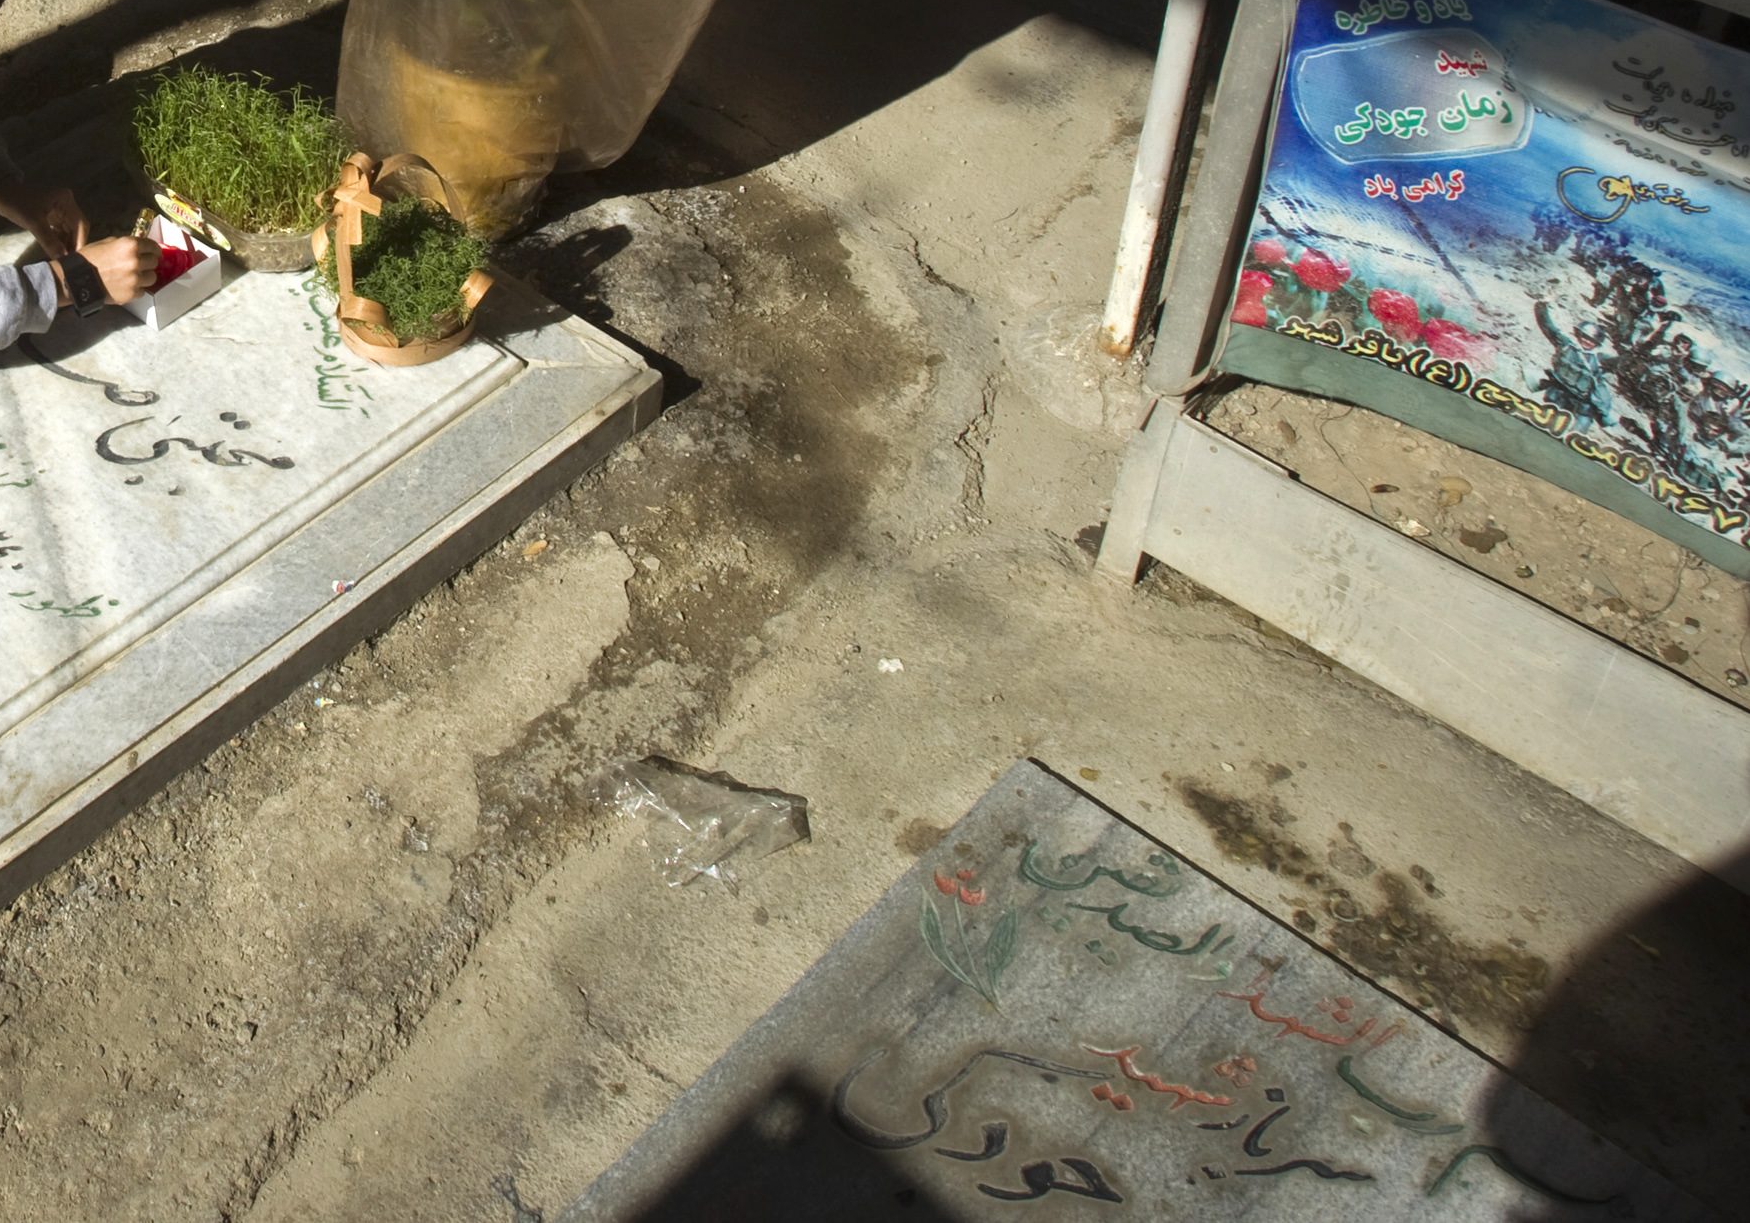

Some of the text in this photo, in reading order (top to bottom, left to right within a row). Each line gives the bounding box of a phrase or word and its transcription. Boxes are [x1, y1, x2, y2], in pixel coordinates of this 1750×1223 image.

[1435, 49, 1490, 78] شهید
[1333, 100, 1429, 145] جودکی
[1438, 89, 1514, 132] زمان
[1363, 169, 1466, 203] گرامی باد
